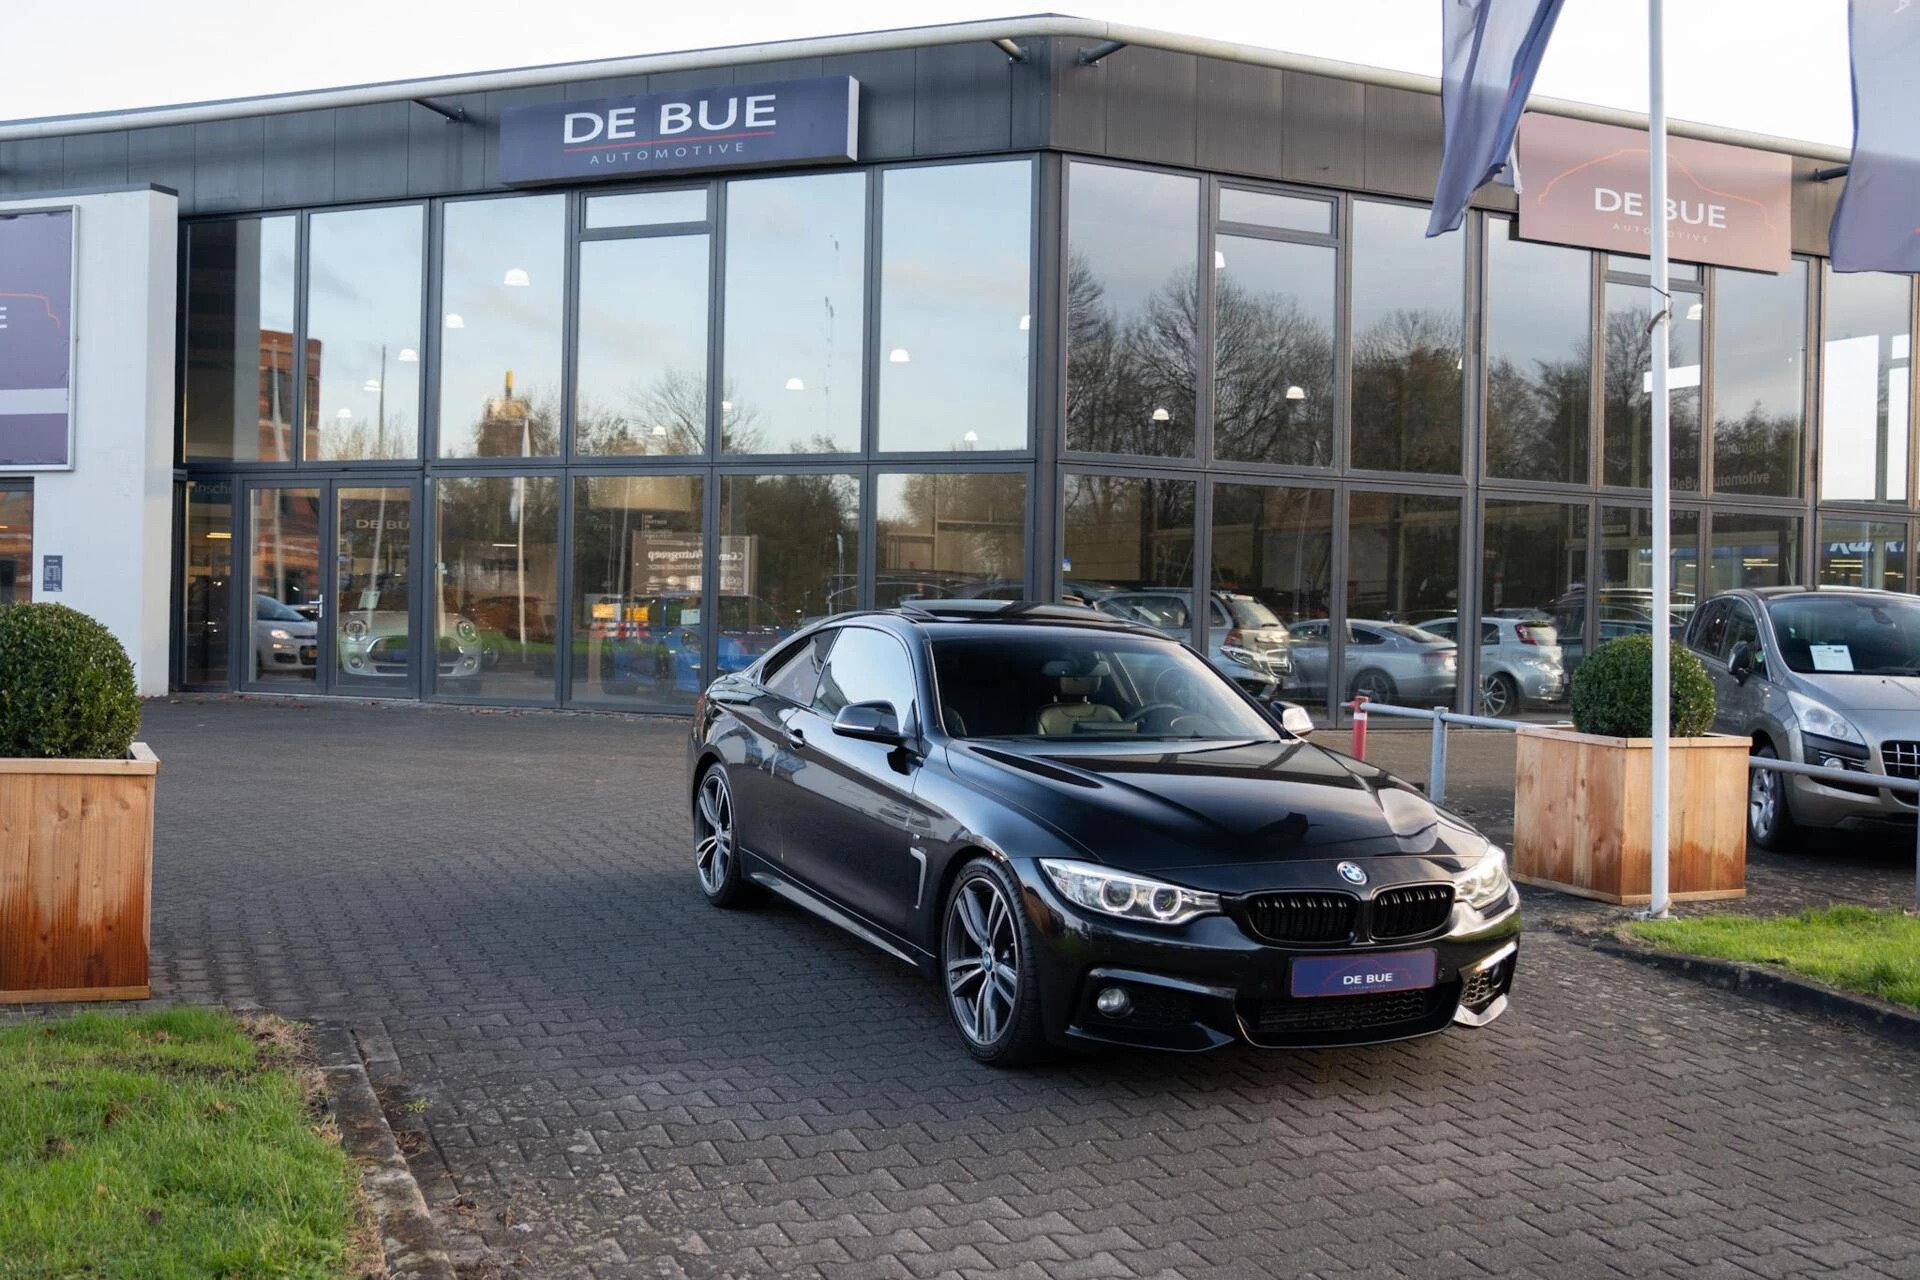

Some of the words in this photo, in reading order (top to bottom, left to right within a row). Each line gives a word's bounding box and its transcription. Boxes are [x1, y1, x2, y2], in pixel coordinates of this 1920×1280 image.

[563, 107, 637, 144] DE
[659, 94, 777, 135] BUE
[590, 142, 744, 165] AUTOMOTIVE
[1594, 187, 1643, 217] DE
[1666, 197, 1727, 229] BUE
[1612, 222, 1708, 243] AUTOOTIVE
[386, 520, 410, 531] BU
[1343, 975, 1362, 985] DE
[1366, 972, 1393, 984] BUE
